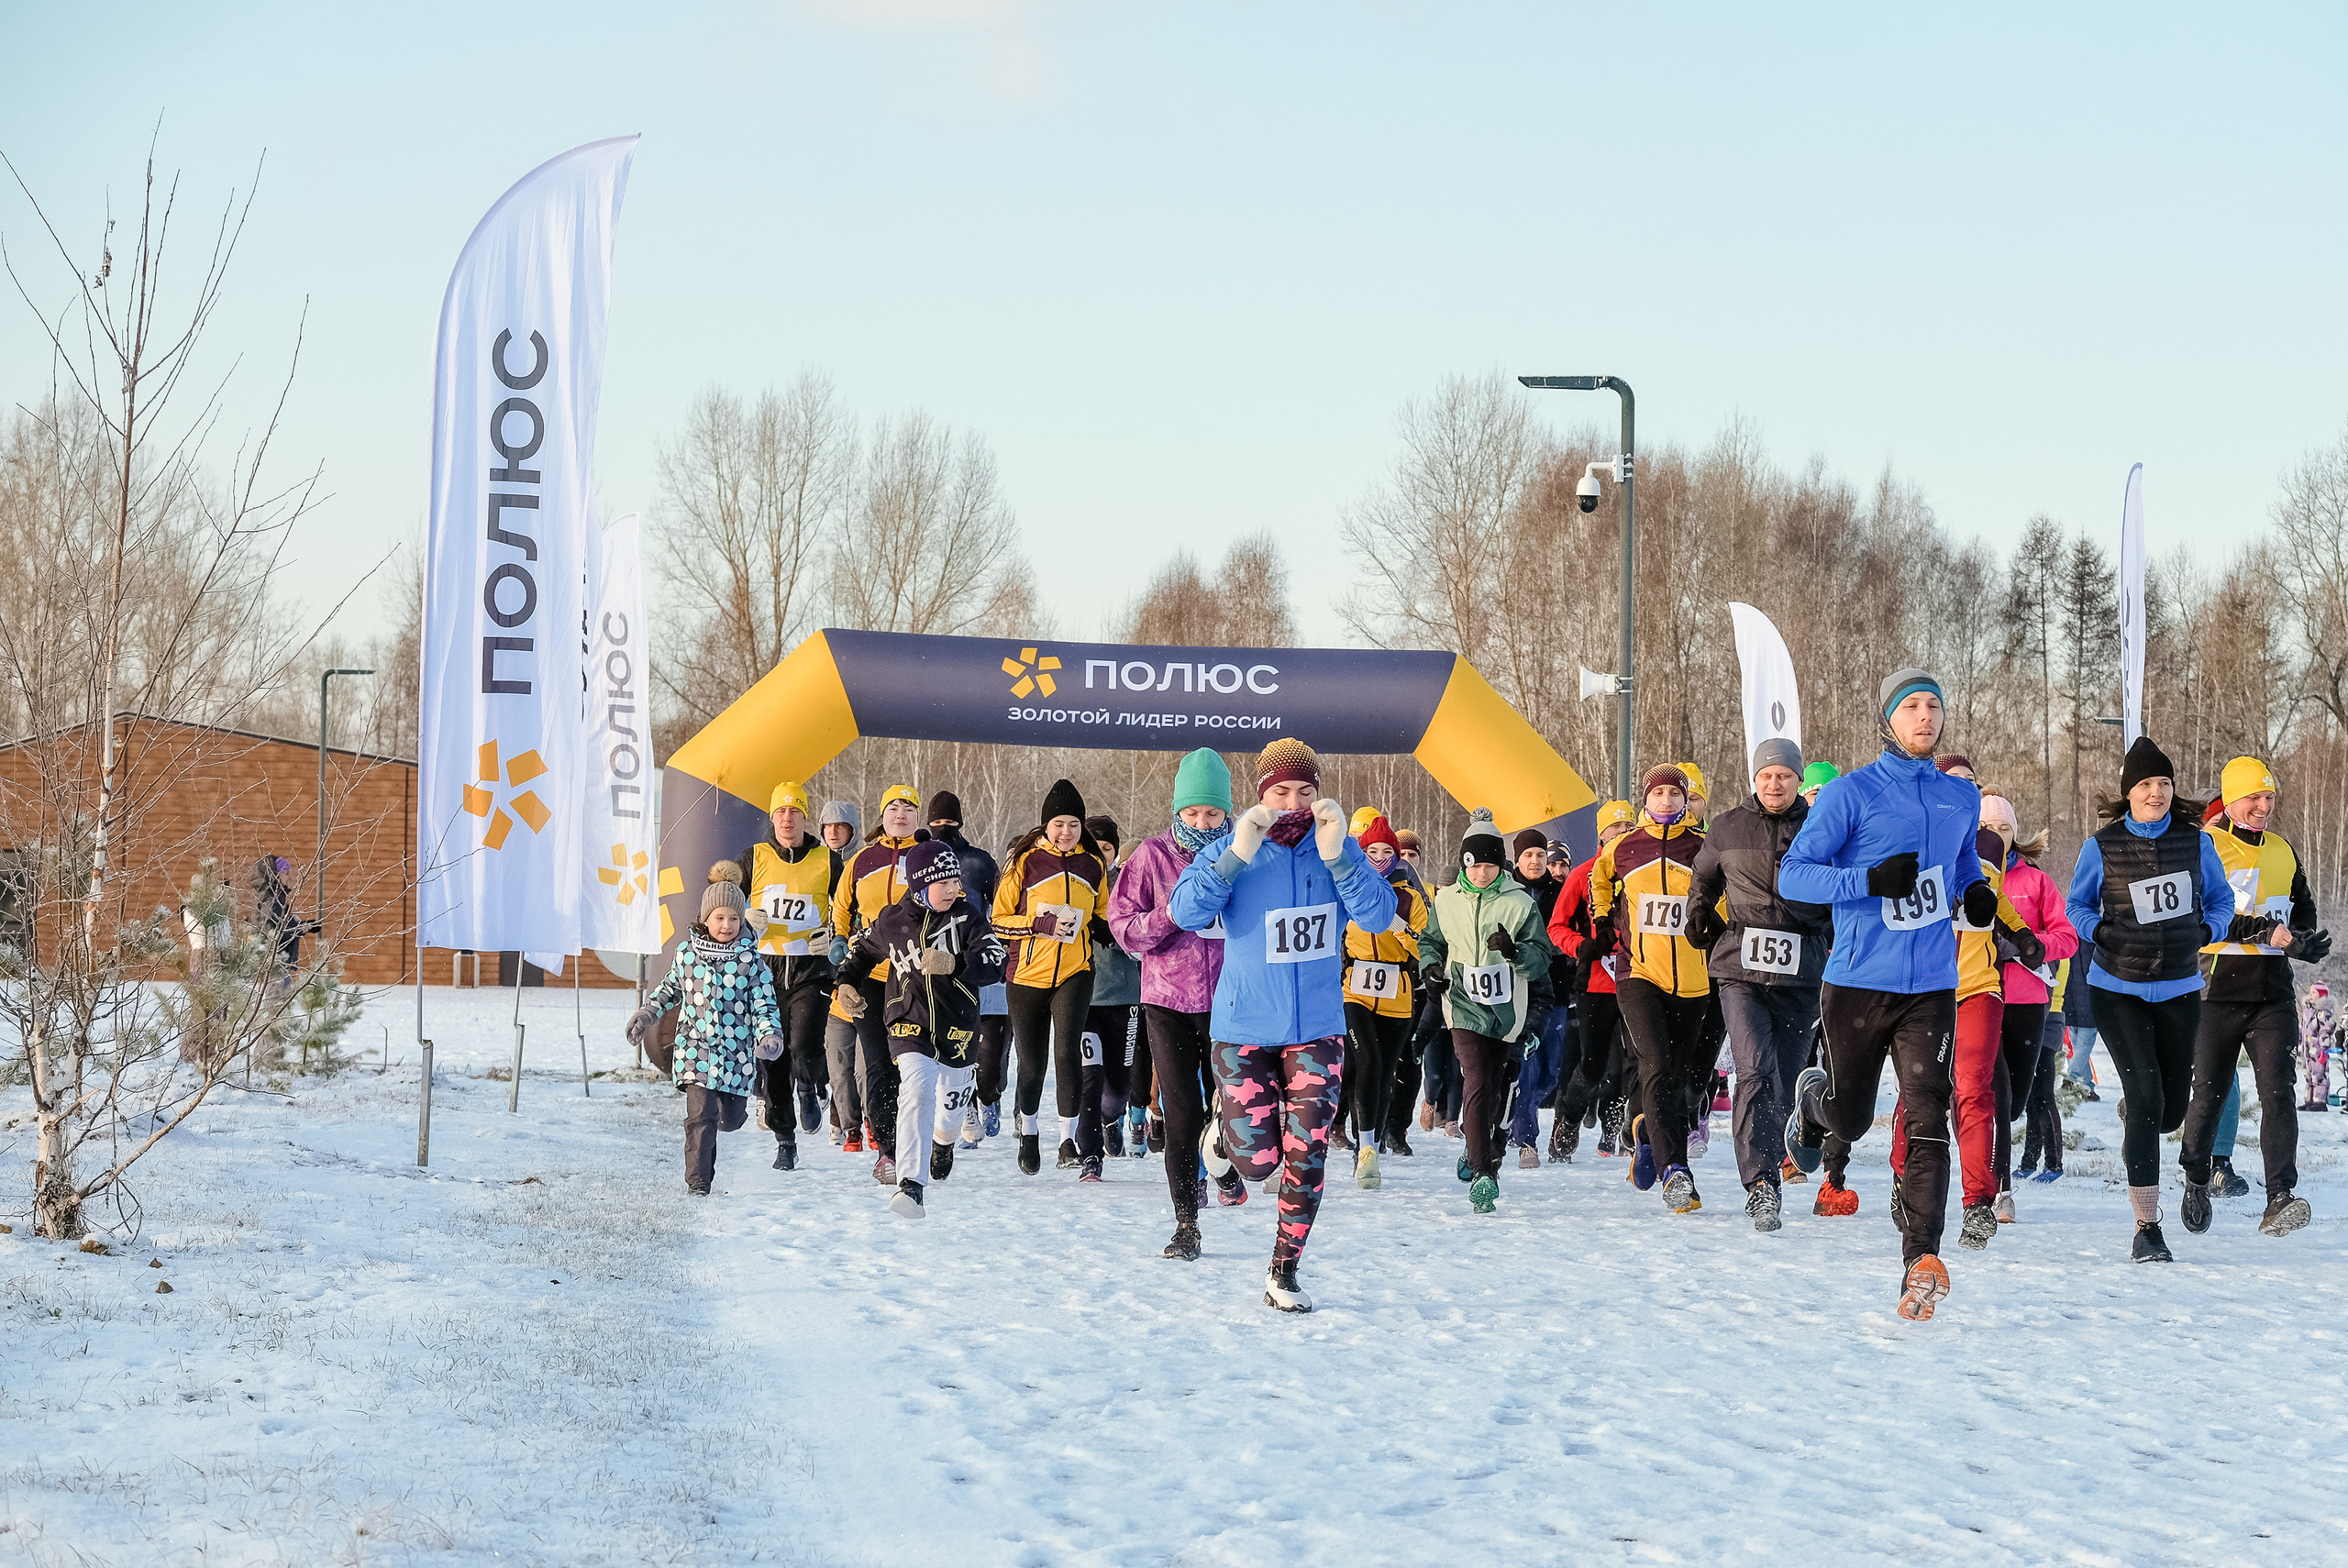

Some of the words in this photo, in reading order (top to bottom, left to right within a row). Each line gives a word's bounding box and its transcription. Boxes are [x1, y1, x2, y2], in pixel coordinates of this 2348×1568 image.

[482, 327, 548, 695] ПОЛЮС
[1085, 659, 1279, 695] ПОЛЮС
[602, 611, 641, 820] ПОЛЮС
[1007, 706, 1110, 725] ЗОЛОТОЙ
[1115, 712, 1189, 730] ЛИДЕР
[1194, 714, 1281, 730] РОССИИ
[912, 866, 936, 880] UEFA
[772, 897, 806, 922] 172
[1892, 878, 1938, 922] 199
[2144, 881, 2179, 914] 78
[1644, 900, 1682, 928] 179
[1276, 913, 1327, 954] 187
[1749, 935, 1793, 966] 153
[1362, 966, 1387, 991] 19
[1470, 970, 1503, 999] 191
[1937, 1036, 1949, 1063] CRAFT
[944, 1086, 971, 1110] 38
